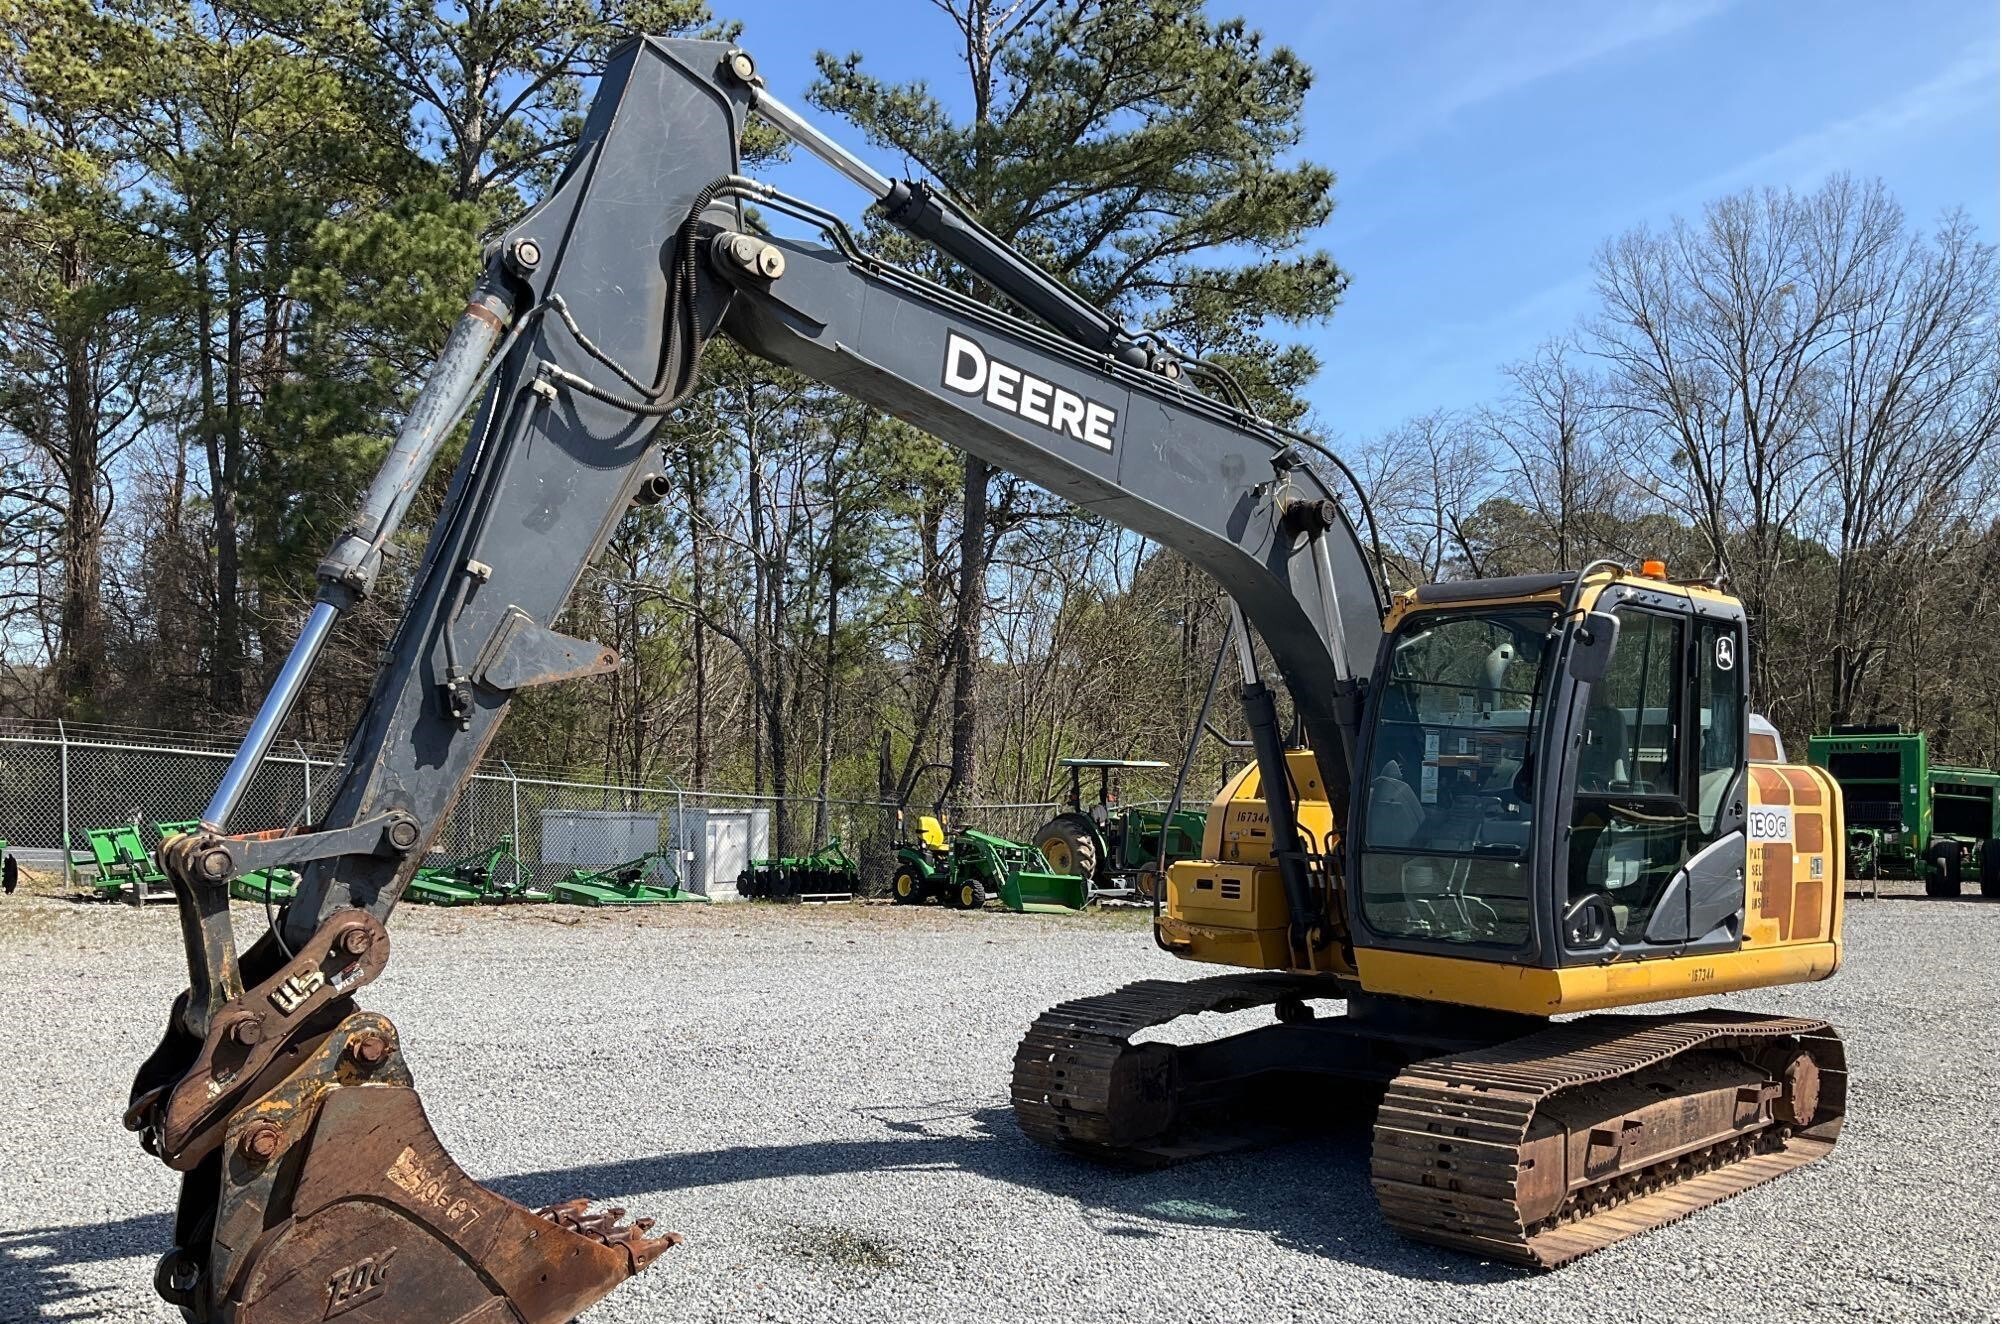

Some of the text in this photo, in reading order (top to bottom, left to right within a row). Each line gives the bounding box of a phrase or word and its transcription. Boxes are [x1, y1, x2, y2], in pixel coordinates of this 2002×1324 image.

[943, 332, 1117, 452] DEERE
[1236, 811, 1271, 824] 167344
[1750, 812, 1787, 838] 130G
